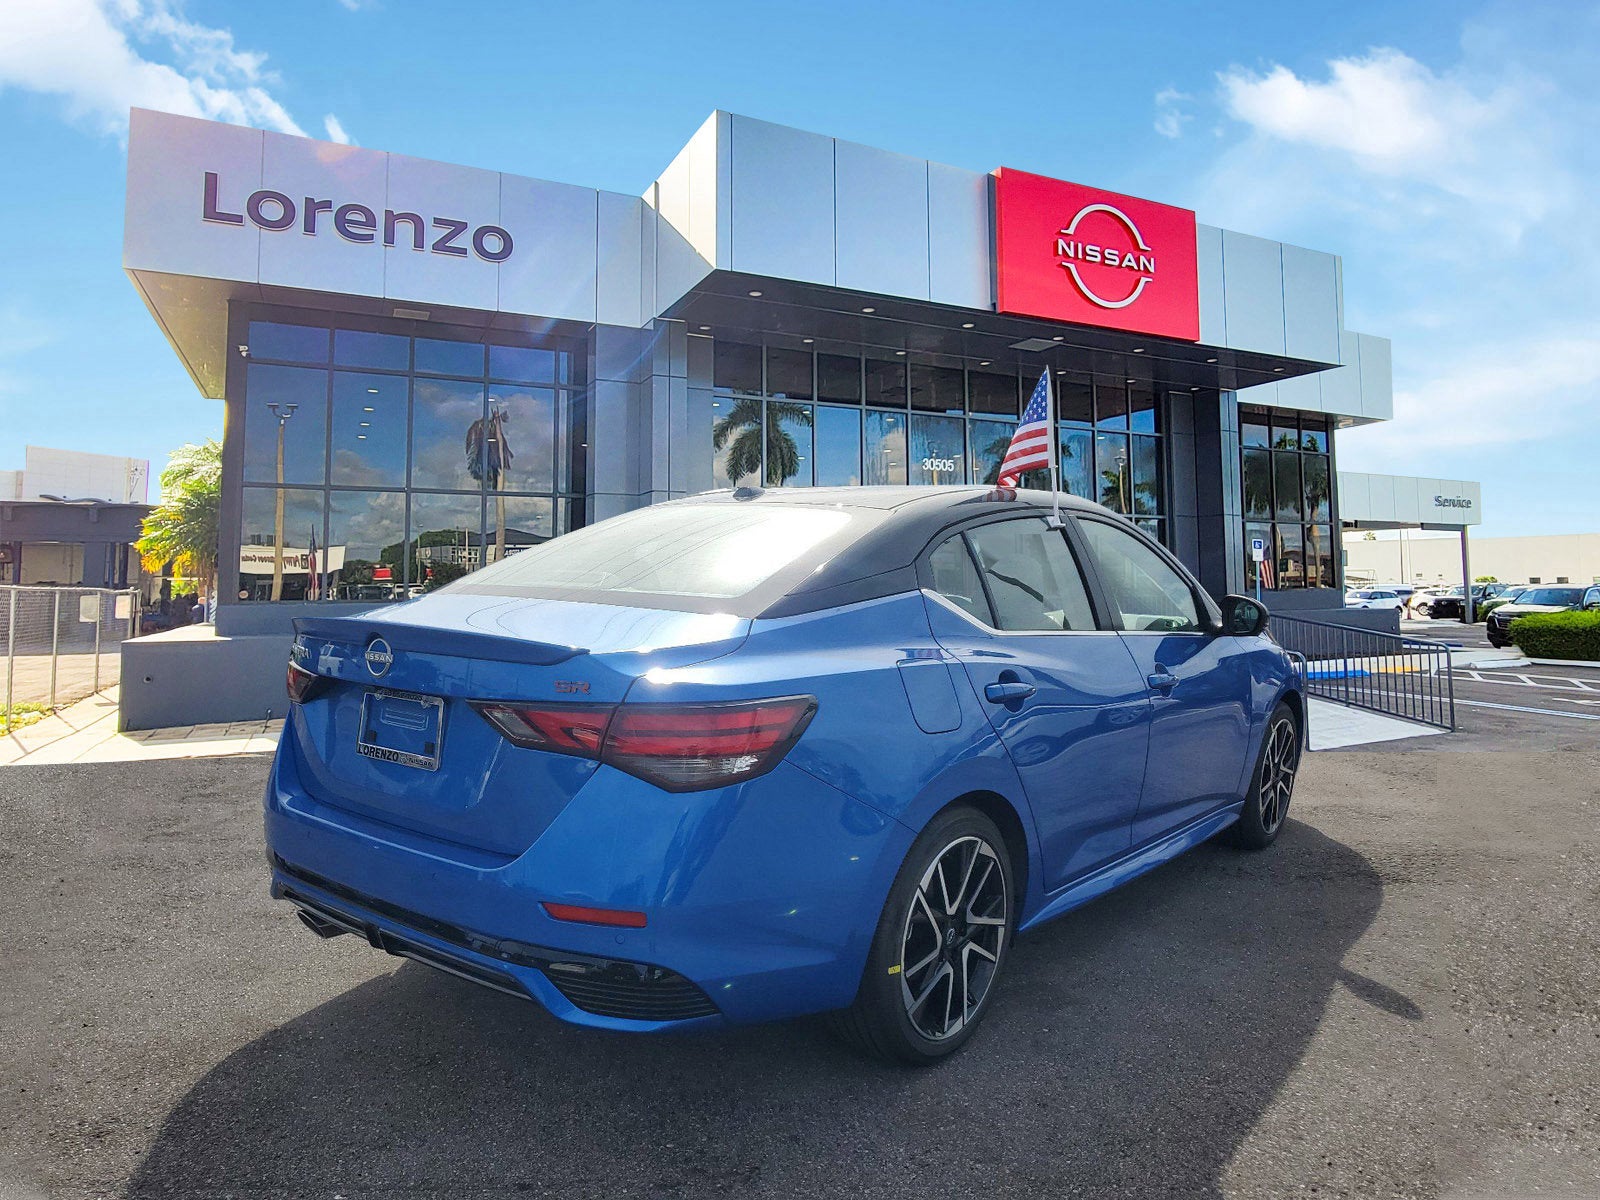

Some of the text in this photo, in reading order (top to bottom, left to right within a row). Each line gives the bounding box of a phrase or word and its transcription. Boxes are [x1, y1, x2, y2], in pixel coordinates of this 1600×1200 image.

[202, 171, 514, 263] Lorenzo
[1057, 238, 1155, 273] NISSAN
[922, 457, 955, 471] 30505
[1434, 495, 1472, 508] Service
[554, 680, 592, 696] SR
[357, 743, 434, 768] LORENZO NISSAN
